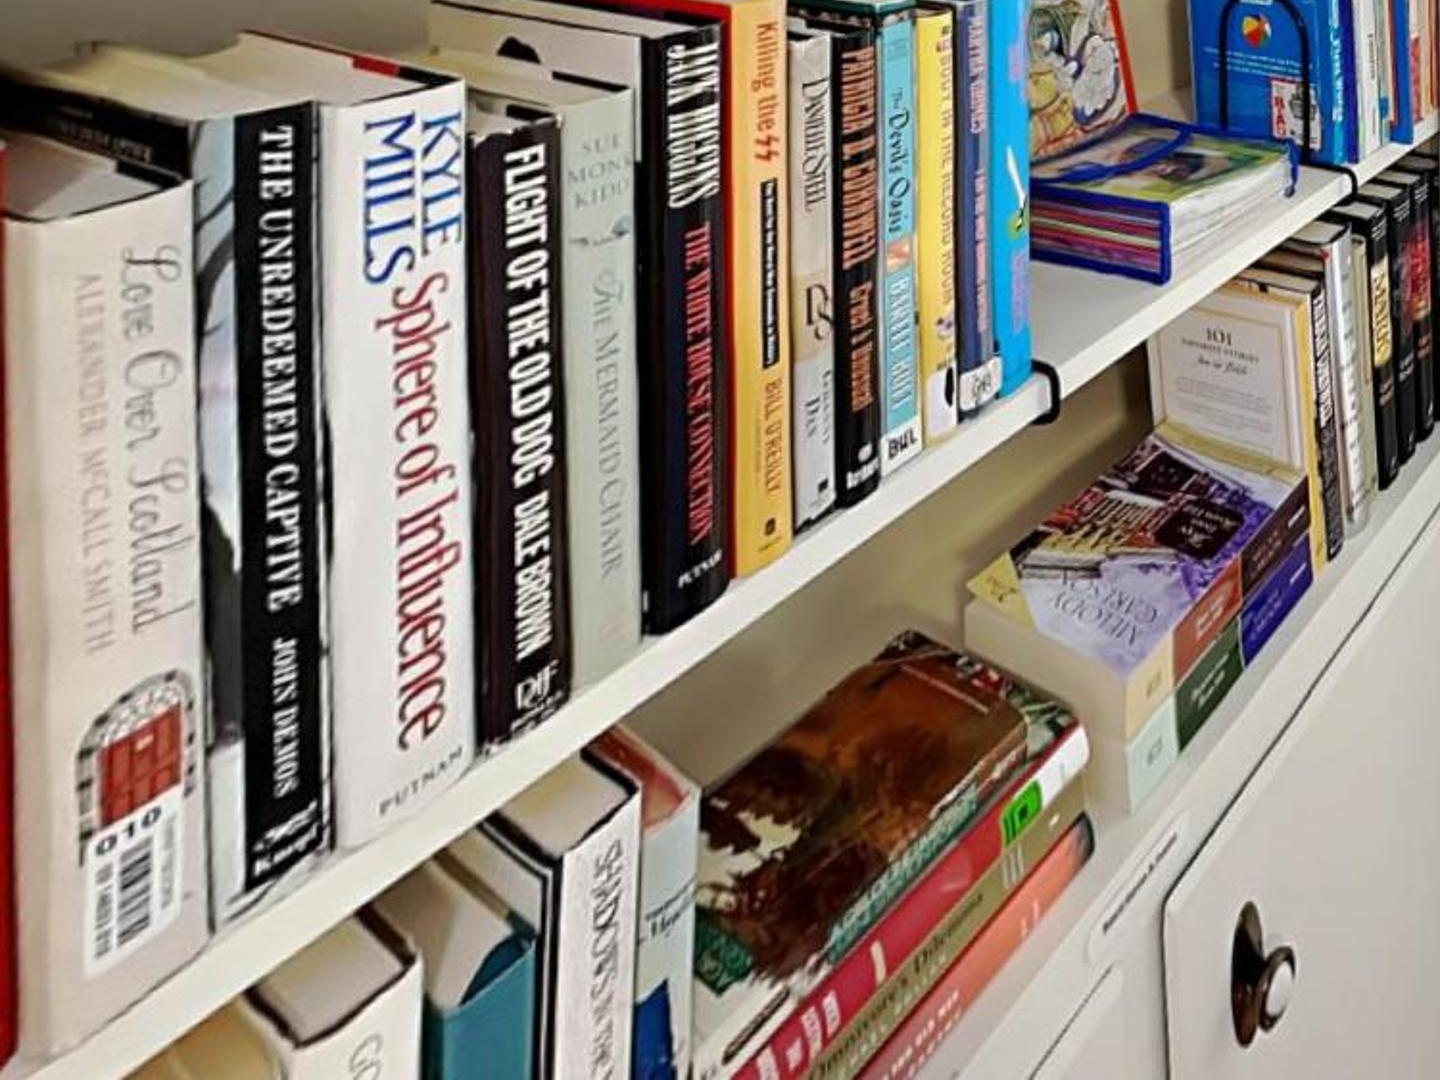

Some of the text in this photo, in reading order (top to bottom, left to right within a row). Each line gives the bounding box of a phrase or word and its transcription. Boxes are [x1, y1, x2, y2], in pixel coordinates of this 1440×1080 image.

[666, 43, 721, 210] JACK HIGGINS
[750, 20, 779, 93] Killing
[756, 93, 778, 133] the
[842, 45, 876, 137] PATRICIA
[364, 113, 416, 286] MILLS
[421, 110, 464, 258] KYLE
[801, 76, 831, 214] DANIELLE STEEL
[842, 156, 876, 271] CORNWELL
[887, 109, 910, 235] Devil's Oasis
[257, 126, 303, 613] THE UNREDEEMED CAPTIVE
[503, 142, 554, 490] FLIGHT OF THE OLD DOG
[684, 221, 714, 546] THE WHITE HOUSE CONNECTION
[74, 272, 115, 656] ALEXANDER SMITH
[120, 244, 196, 637] Love Over Scotland
[593, 331, 627, 581] MERMAID CHAIR
[764, 377, 784, 495] BILL O'REILLY
[375, 272, 463, 752] Sphere of Influence
[513, 489, 552, 568] DALE
[514, 555, 552, 662] BROWN
[272, 635, 299, 801] JOHN DEMOS
[377, 745, 463, 816] PUTNAM
[94, 806, 163, 857] 010
